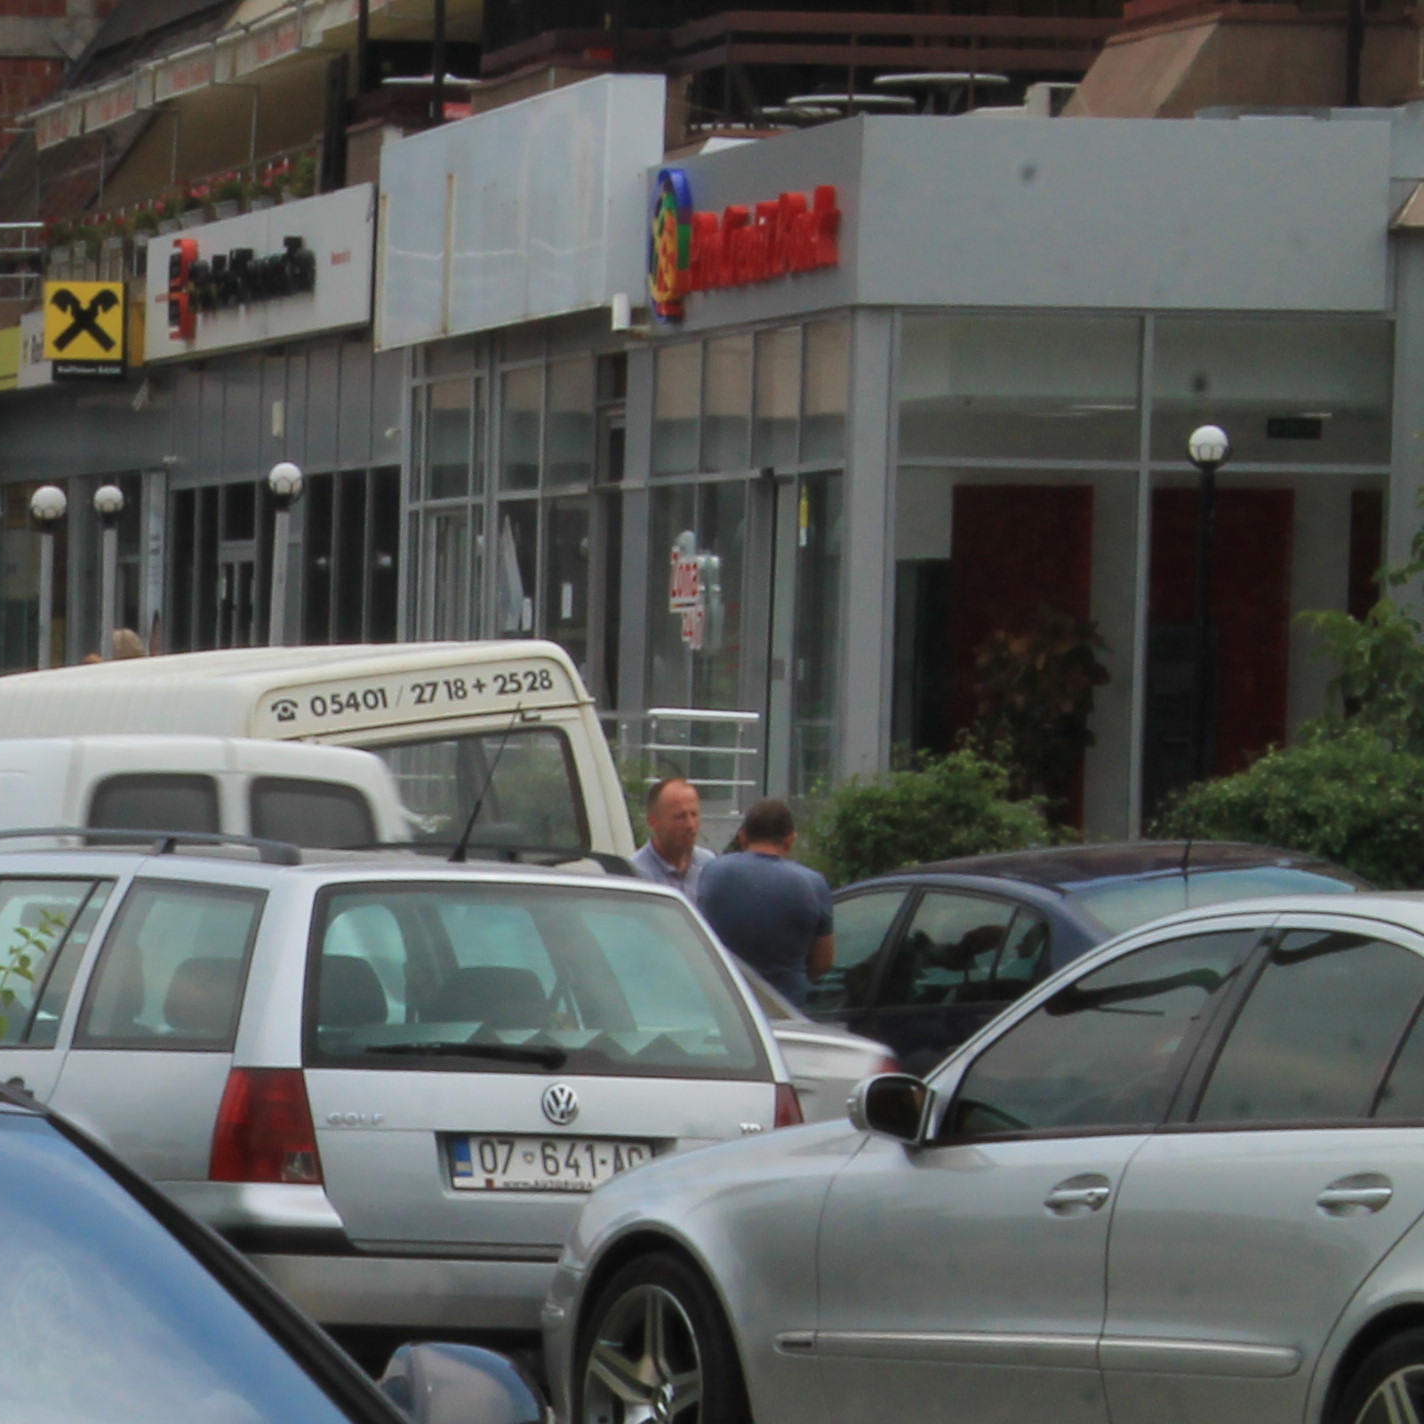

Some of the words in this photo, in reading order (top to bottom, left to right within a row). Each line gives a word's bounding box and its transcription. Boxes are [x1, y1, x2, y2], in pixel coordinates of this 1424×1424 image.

[309, 688, 388, 718] 05401
[410, 679, 468, 705] 2718
[492, 669, 553, 696] 2528
[326, 1112, 385, 1125] GOLF
[478, 1139, 515, 1175] 07
